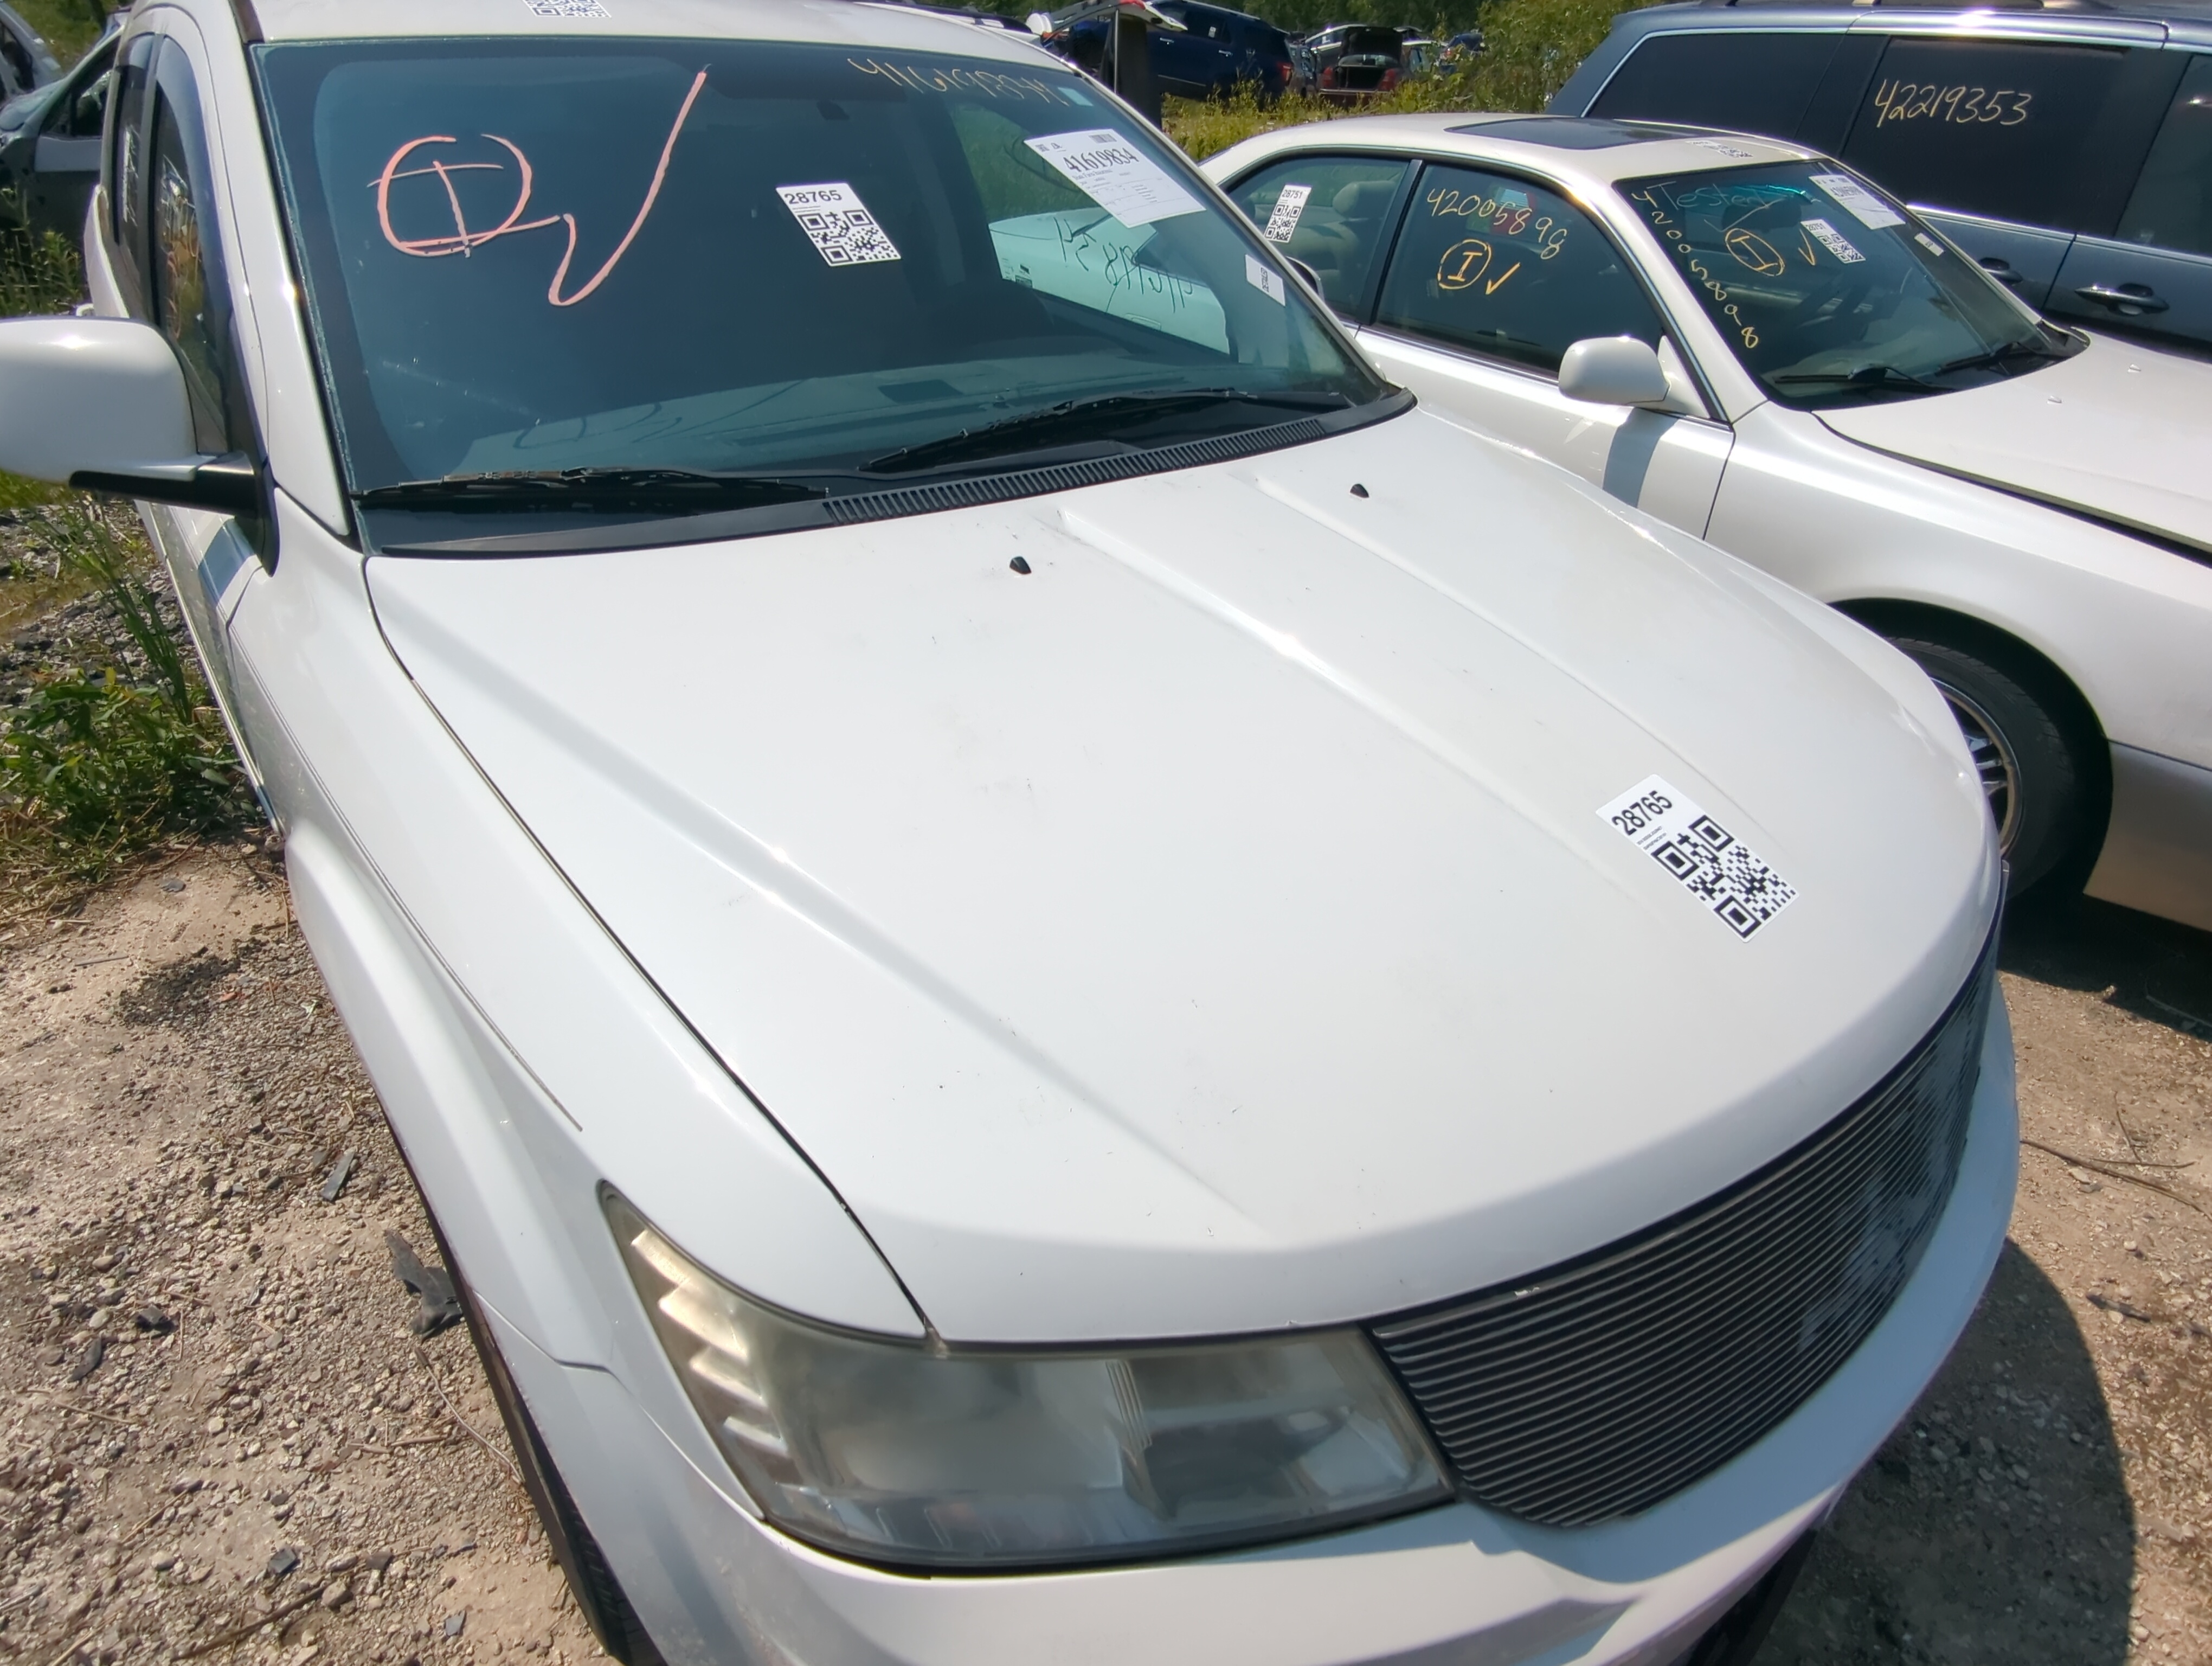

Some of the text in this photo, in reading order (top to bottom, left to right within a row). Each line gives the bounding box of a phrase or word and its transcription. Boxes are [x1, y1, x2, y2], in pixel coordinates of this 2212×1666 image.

[1875, 79, 2032, 128] 42219353
[1063, 147, 1140, 172] 41619834
[784, 190, 842, 204] 28765
[1282, 189, 1303, 199] 28751
[1427, 188, 1568, 260] 42005898
[1631, 190, 1759, 349] 42005898
[1611, 790, 1673, 836] 28765
